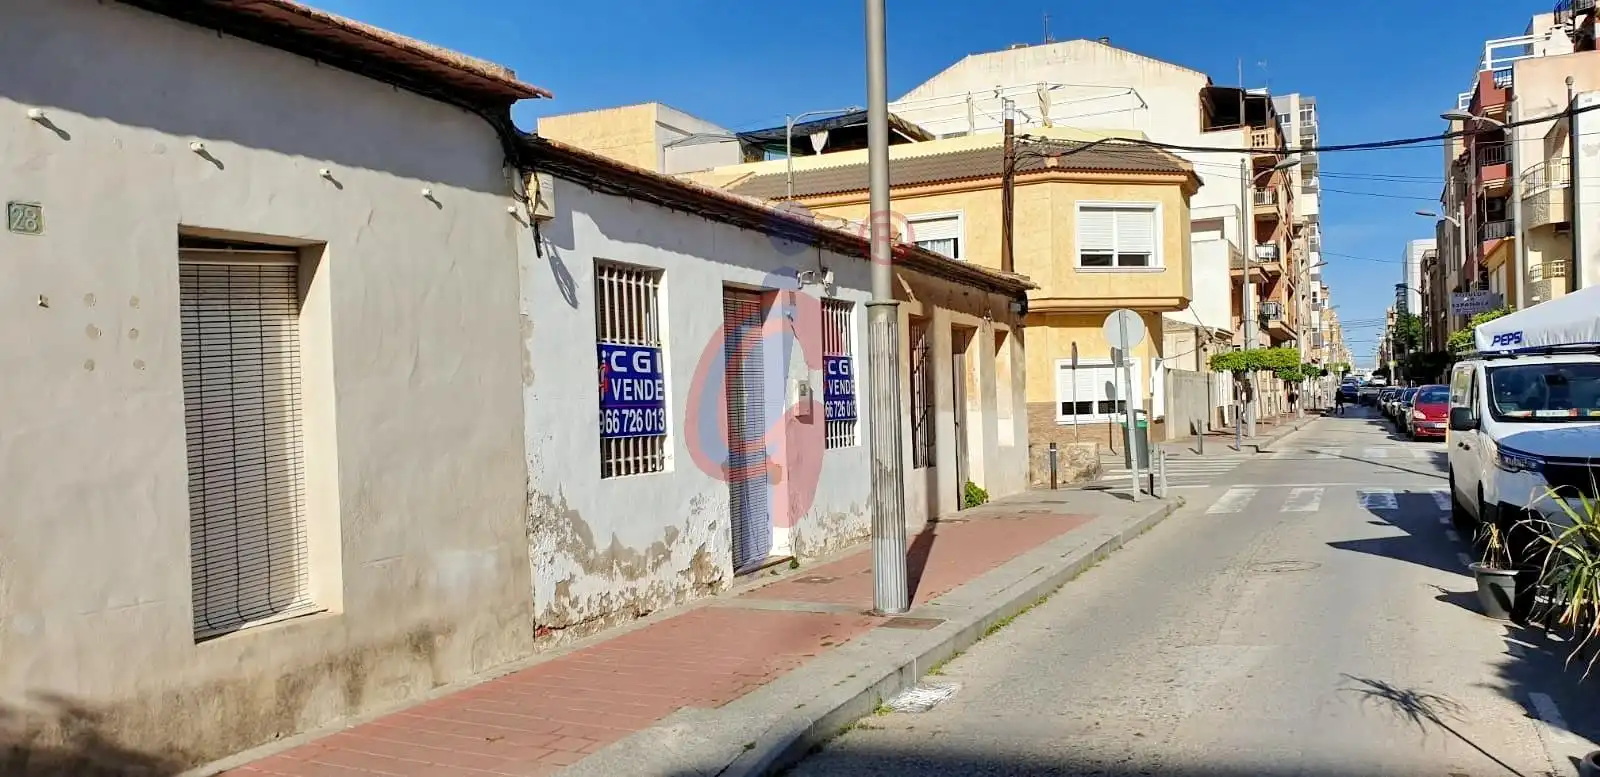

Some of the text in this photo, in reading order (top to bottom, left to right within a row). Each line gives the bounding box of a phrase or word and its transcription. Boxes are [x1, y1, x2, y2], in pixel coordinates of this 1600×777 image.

[12, 207, 38, 231] 28
[1491, 330, 1523, 347] PEPSI
[611, 378, 665, 401] VENDE
[828, 379, 855, 395] VENDE
[834, 400, 846, 418] 726
[600, 408, 665, 434] 966 726 013
